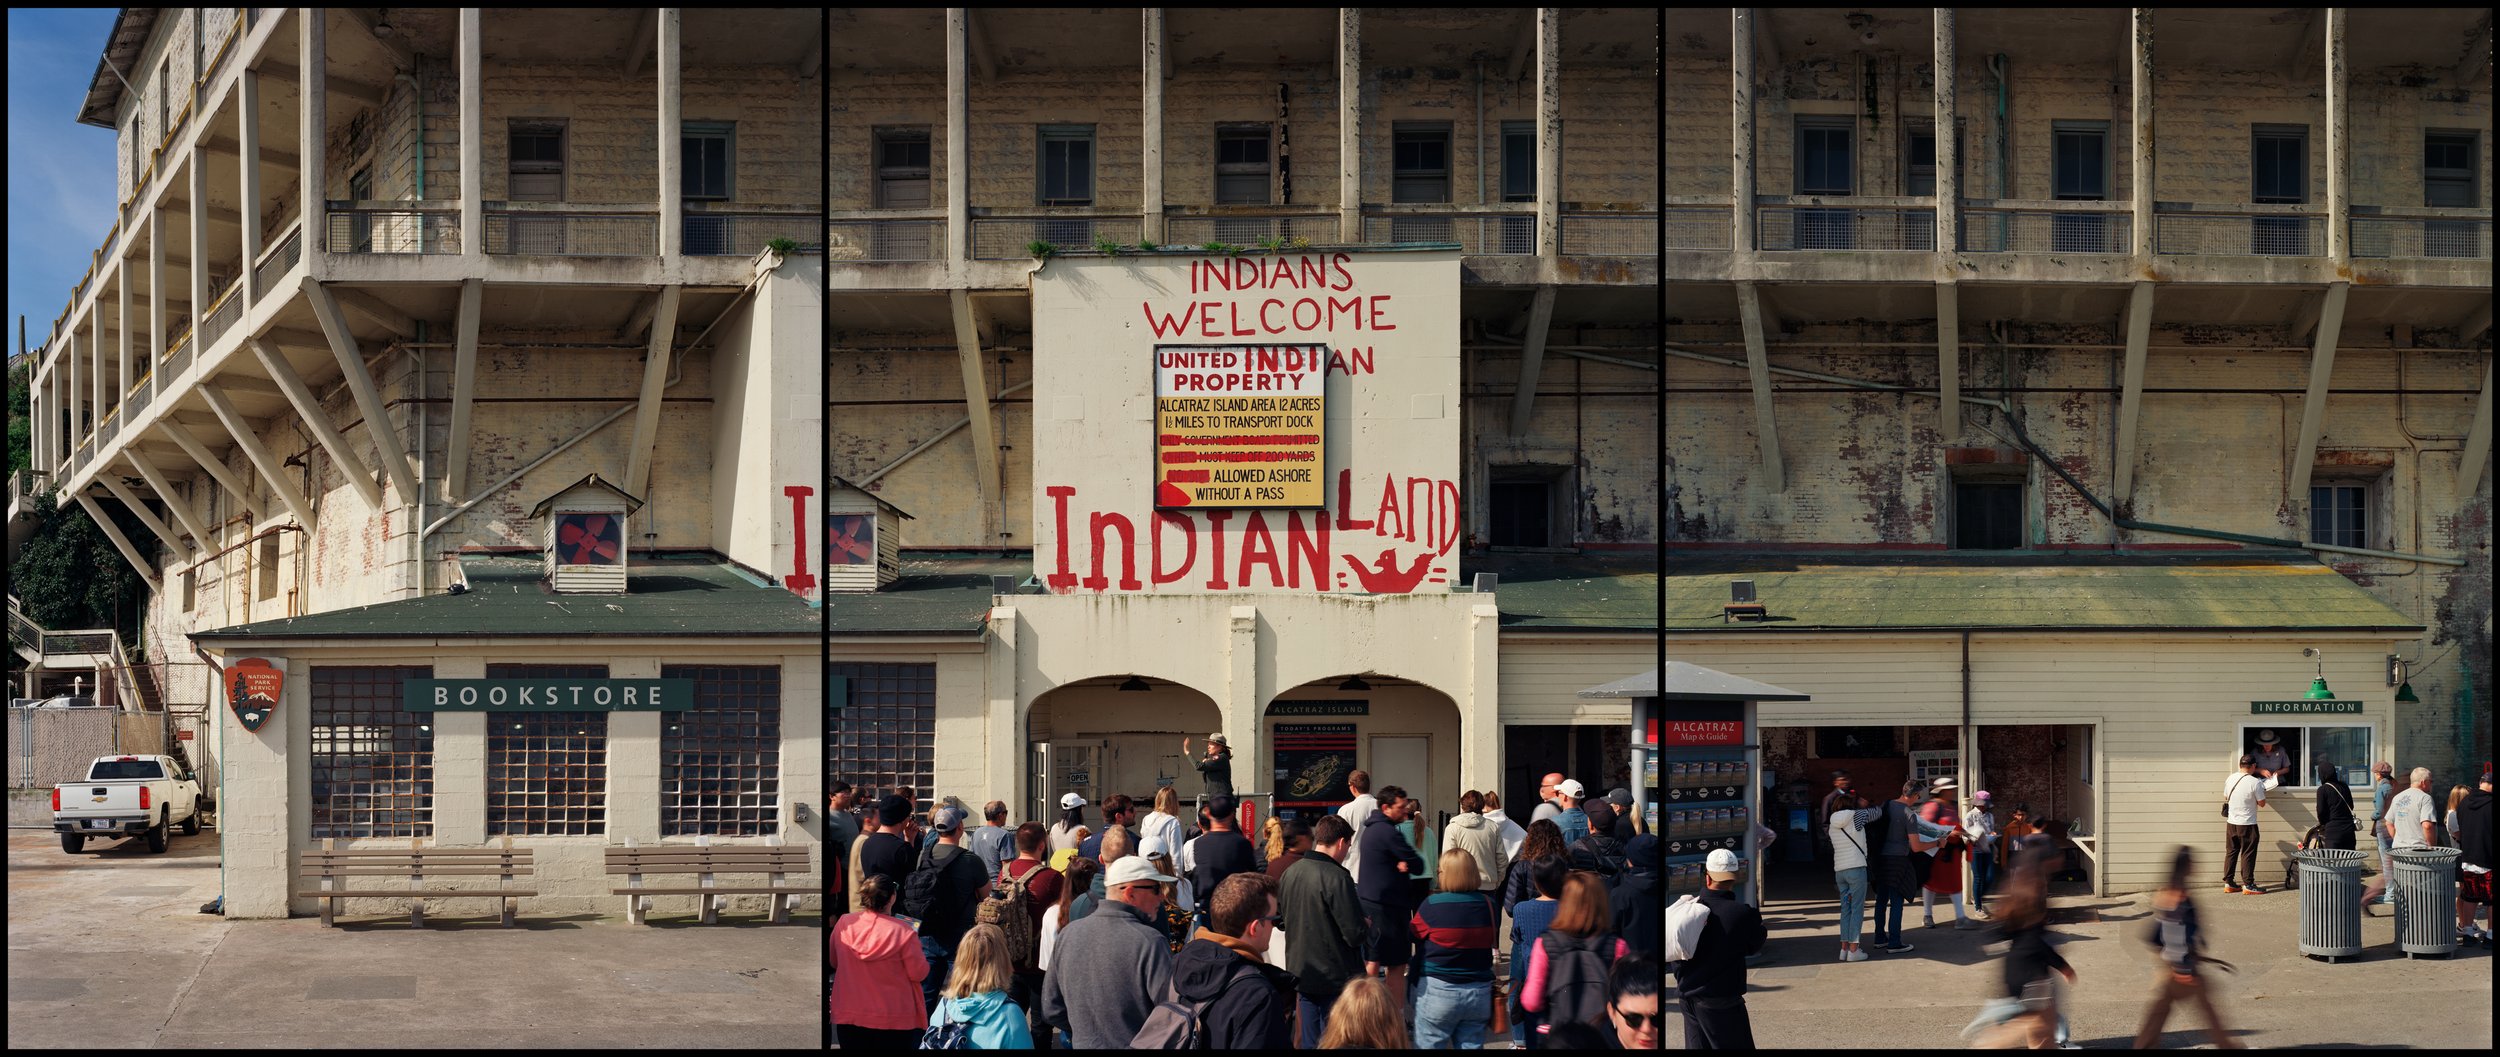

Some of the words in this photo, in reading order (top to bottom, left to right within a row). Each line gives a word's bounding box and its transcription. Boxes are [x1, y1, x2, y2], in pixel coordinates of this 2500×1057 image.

[1191, 253, 1353, 293] INDIANS
[1143, 295, 1397, 339] WELCOME
[1159, 352, 1237, 368] UNITED
[1174, 373, 1305, 391] PROPERTY
[1159, 399, 1210, 412] ALCATRAZ
[1213, 399, 1248, 411] ISLAND
[1250, 399, 1276, 411] AREA
[1279, 399, 1288, 411] 12
[1289, 398, 1321, 411] ACRES
[1175, 416, 1204, 428] MILES
[1207, 416, 1220, 428] TO
[1223, 416, 1283, 427] TRANSPORT
[1286, 416, 1314, 427] DOCK
[1286, 450, 1316, 462] YARDS
[1213, 469, 1265, 483] ALLOWED
[1268, 469, 1311, 483] ASHORE
[1195, 487, 1241, 500] WITHOUT
[1243, 488, 1252, 500] A
[1256, 487, 1284, 500] PASS
[434, 686, 661, 706] BOOKSTORE
[2259, 703, 2355, 712] INFORMATION
[1673, 722, 1735, 732] ALCATRAZ
[1680, 733, 1697, 742] Map
[1699, 733, 1705, 741] &
[1706, 733, 1728, 741] Guide
[1070, 774, 1088, 782] OPEN
